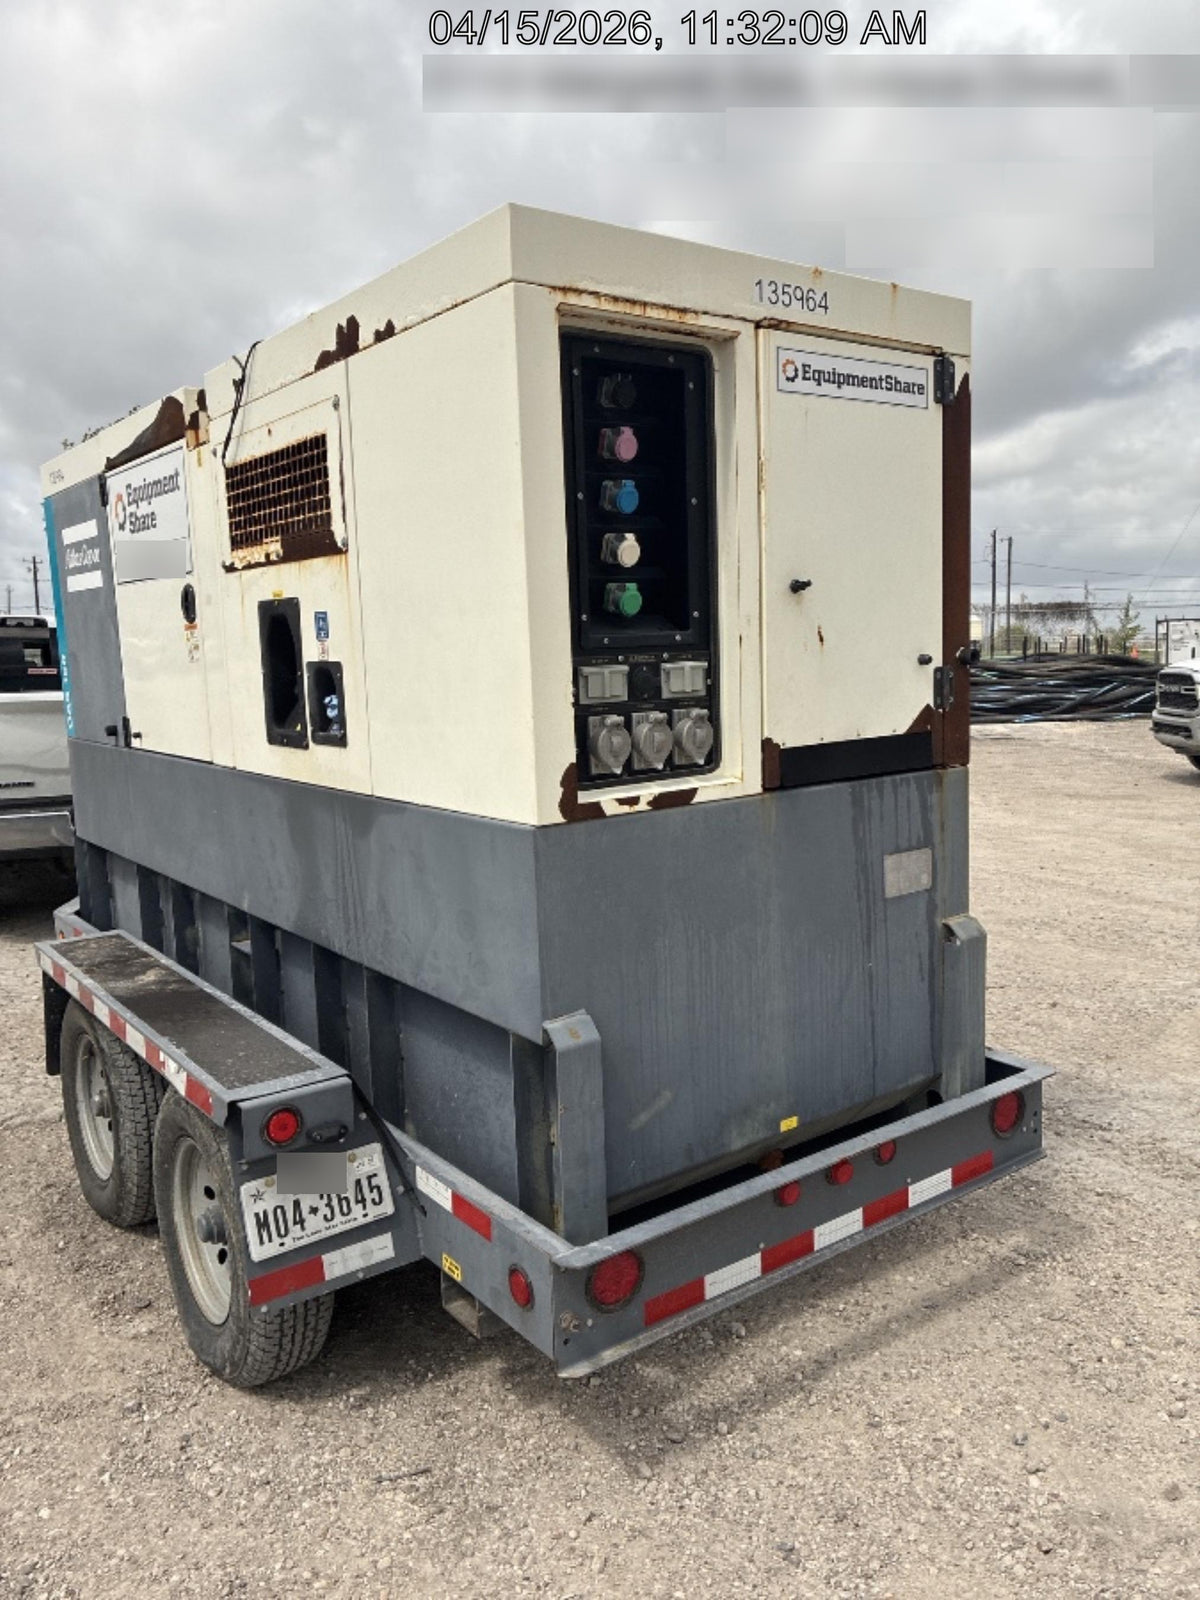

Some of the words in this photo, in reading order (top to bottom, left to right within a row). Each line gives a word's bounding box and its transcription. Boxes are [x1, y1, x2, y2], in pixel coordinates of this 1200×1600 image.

[754, 279, 829, 315] 135964
[801, 363, 926, 396] EquipmentShare
[125, 467, 180, 510] Equipment
[128, 511, 157, 534] Share
